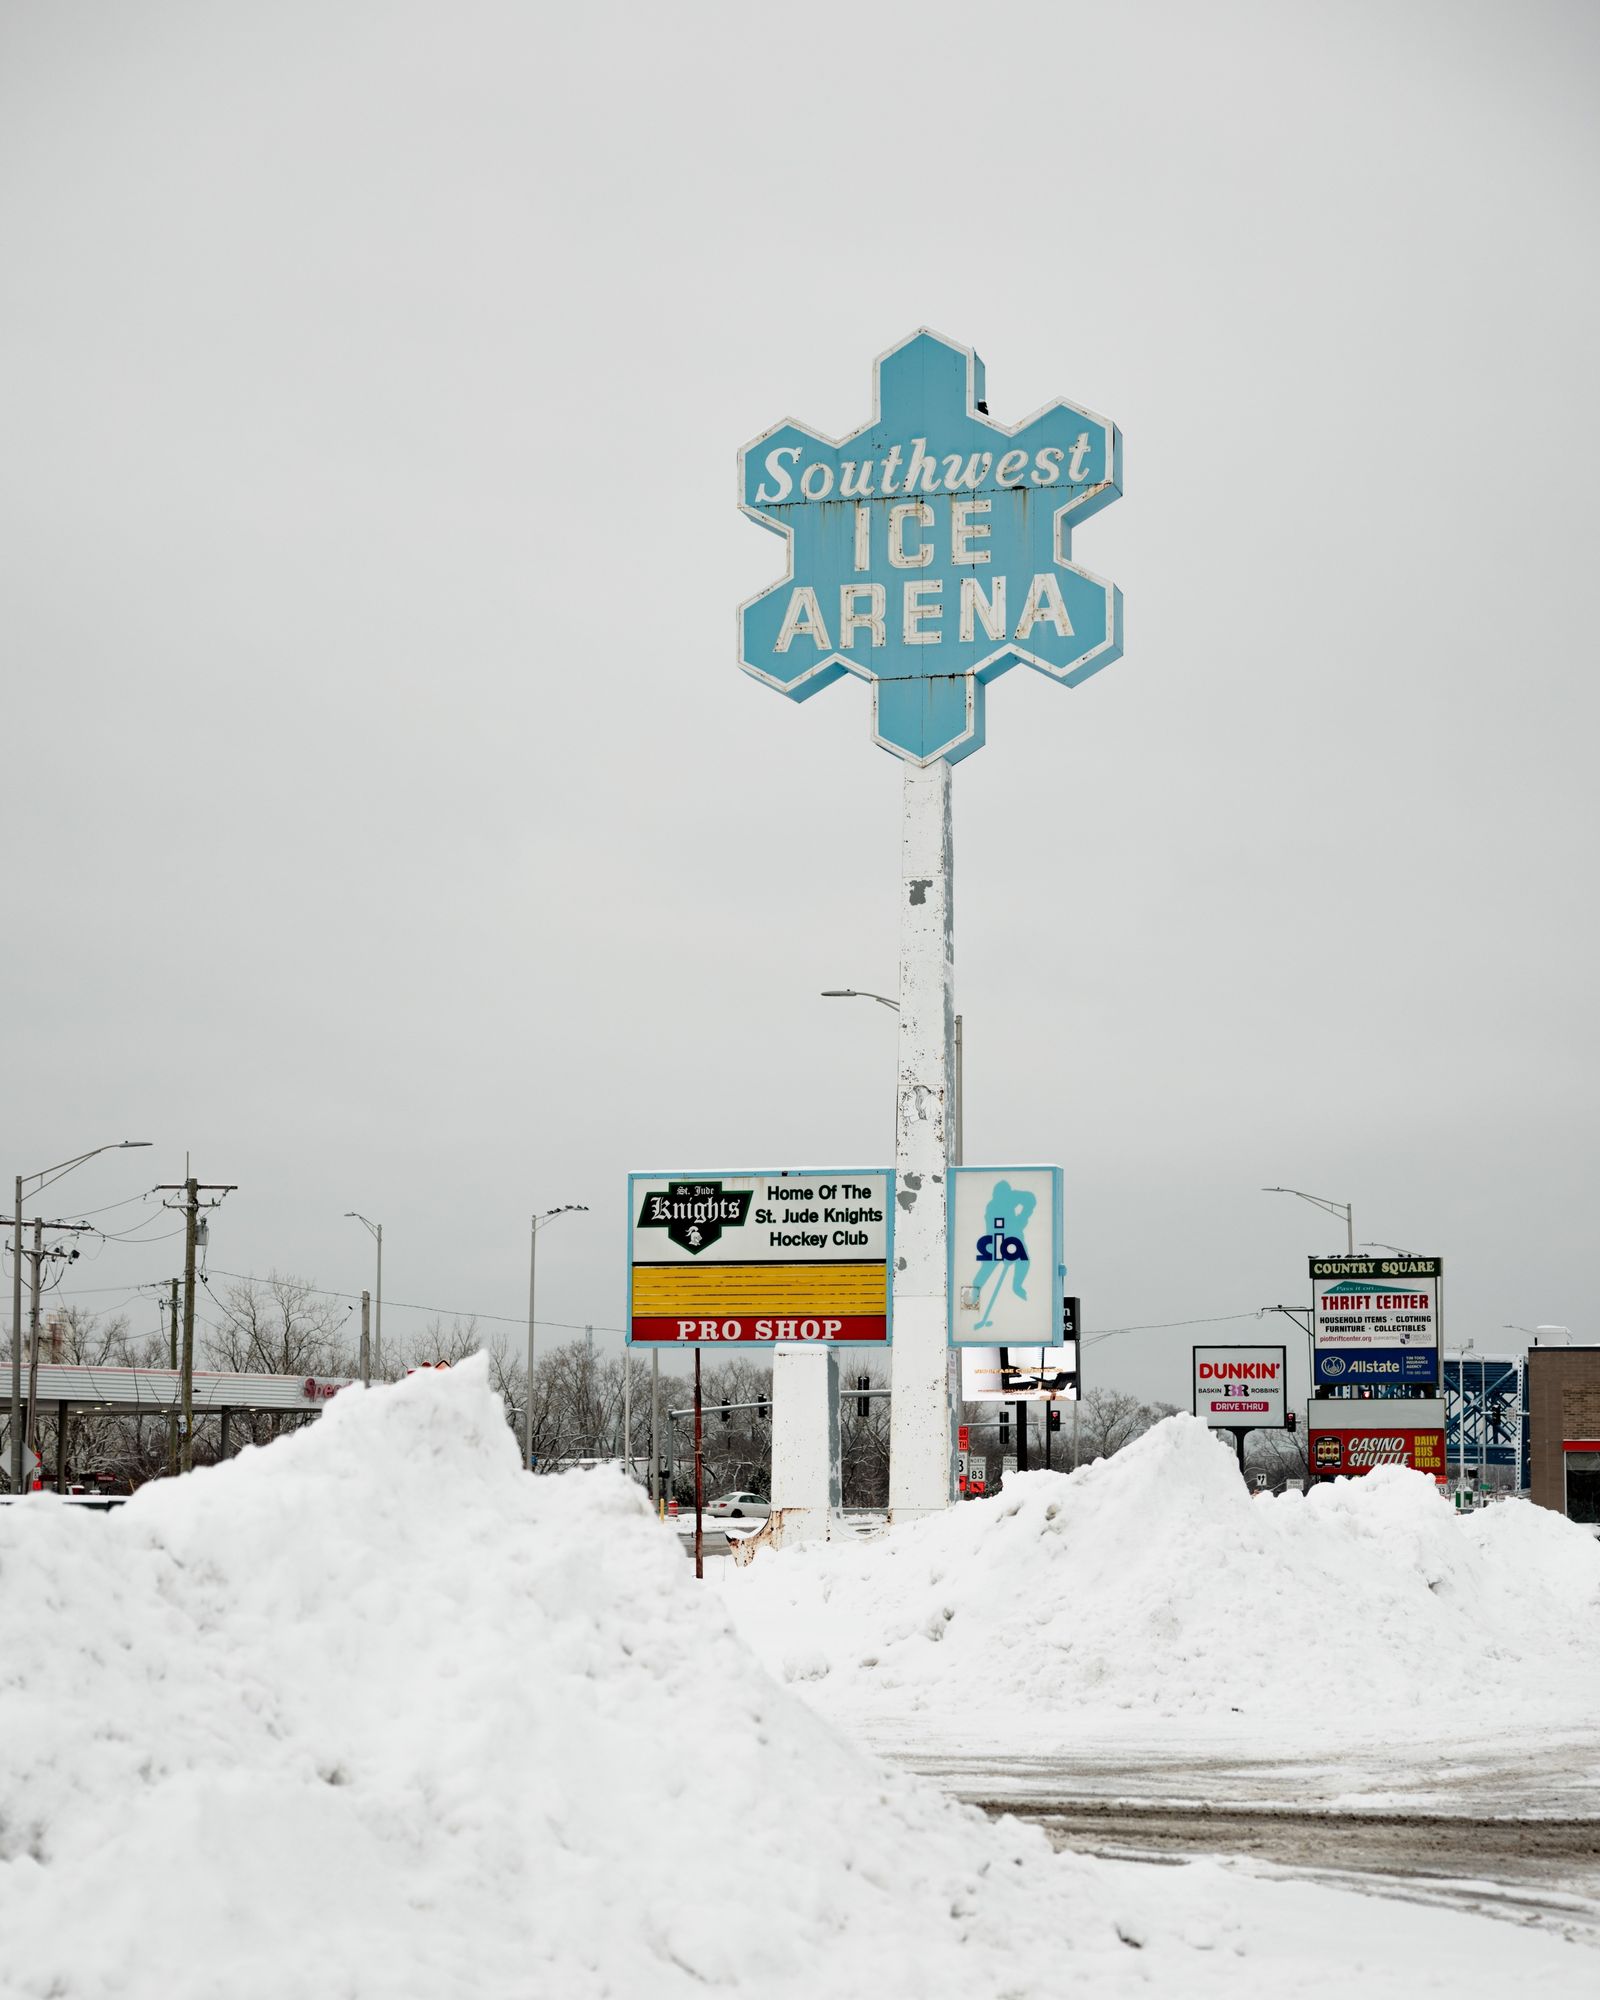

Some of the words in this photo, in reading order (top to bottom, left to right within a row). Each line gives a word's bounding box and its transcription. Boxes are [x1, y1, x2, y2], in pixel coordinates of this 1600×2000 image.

[755, 432, 1091, 503] Southwest
[853, 499, 992, 571] ICE
[773, 573, 1075, 653] ARENA
[694, 1185, 714, 1196] Jude
[767, 1185, 814, 1200] Home
[818, 1184, 838, 1200] Of
[841, 1184, 872, 1200] The
[650, 1196, 740, 1223] Knights
[755, 1208, 776, 1224] St.
[782, 1208, 819, 1223] Jude
[824, 1207, 883, 1224] Knights
[769, 1231, 827, 1248] Hockey
[832, 1230, 868, 1246] Club
[1314, 1262, 1376, 1274] COUNTRY
[1381, 1261, 1435, 1275] SQUARE
[1321, 1295, 1371, 1310] THRIFT
[1376, 1294, 1429, 1309] CENTER
[1320, 1316, 1363, 1324] HOUSEHOLD
[1395, 1315, 1432, 1323] CLOTHING
[677, 1321, 742, 1341] PRO
[755, 1319, 843, 1340] SHOP
[1374, 1324, 1426, 1332] COLLECTIBLES
[1199, 1363, 1280, 1379] DUNKIN'
[1348, 1361, 1400, 1373] Allstate
[1348, 1437, 1405, 1452] CASINO
[1414, 1435, 1439, 1446] DAILY
[1415, 1446, 1433, 1457] BUS
[1415, 1457, 1441, 1468] RIDES
[971, 1470, 983, 1480] 83
